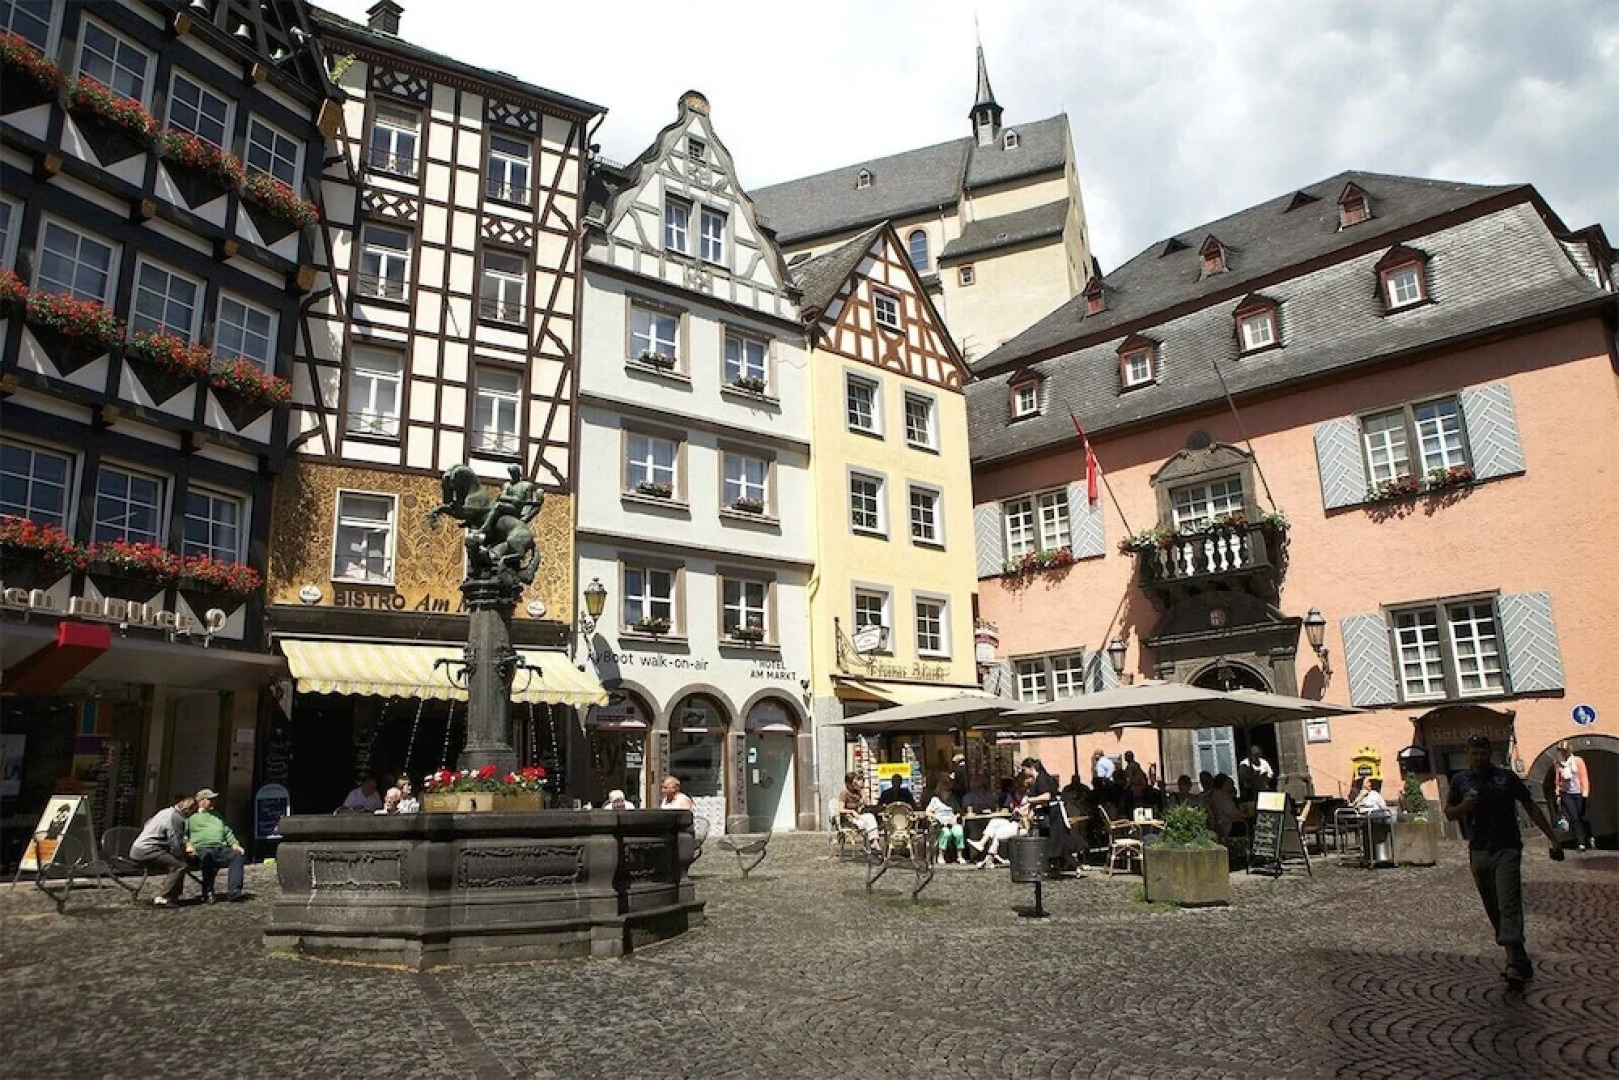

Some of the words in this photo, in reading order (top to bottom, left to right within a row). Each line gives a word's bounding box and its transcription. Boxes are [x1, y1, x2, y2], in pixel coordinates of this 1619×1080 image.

[0, 587, 55, 610] en
[334, 590, 406, 610] BISTRO
[415, 592, 451, 613] Am
[639, 654, 709, 671] walk-on-air
[759, 659, 786, 670] HOTEL
[750, 670, 764, 679] AM
[766, 671, 796, 682] MARKT
